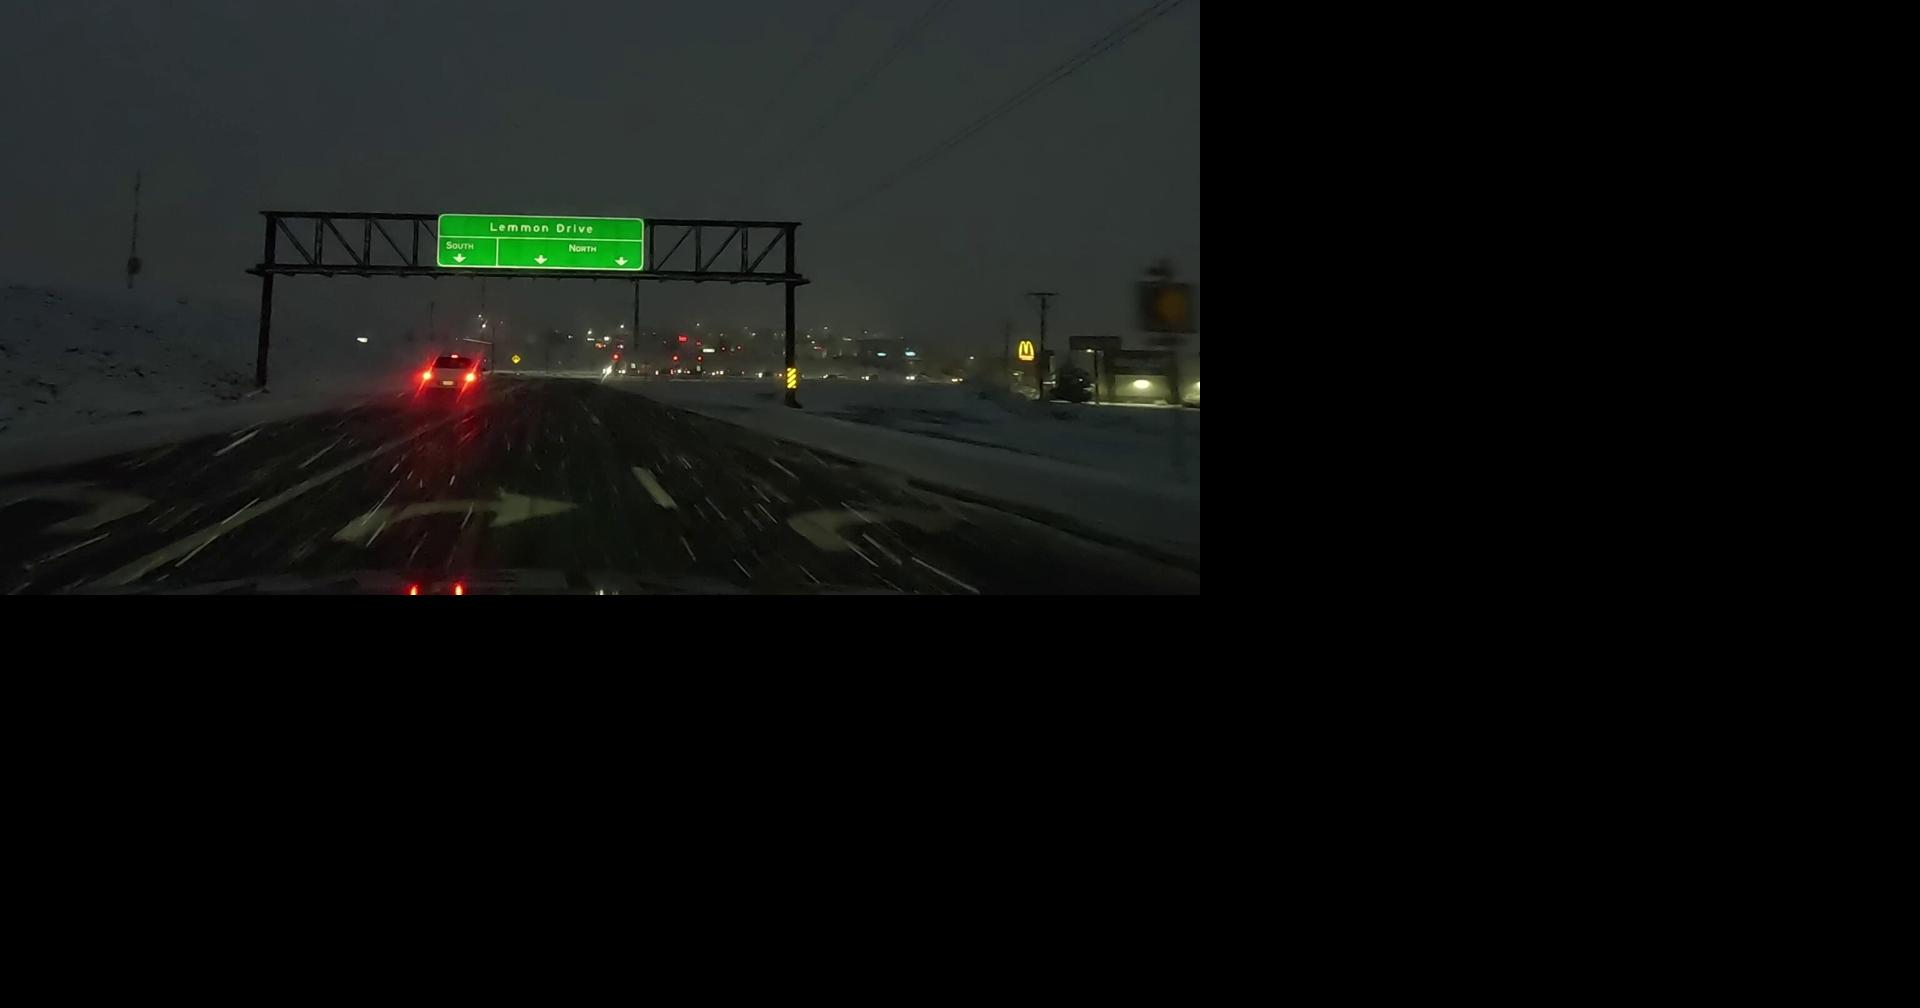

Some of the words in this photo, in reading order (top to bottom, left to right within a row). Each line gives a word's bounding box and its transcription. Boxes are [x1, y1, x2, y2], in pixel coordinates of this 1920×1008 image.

[490, 222, 549, 233] Lemmon
[556, 223, 593, 234] Drive
[446, 241, 474, 250] SOUTH
[568, 244, 597, 253] NORTH
